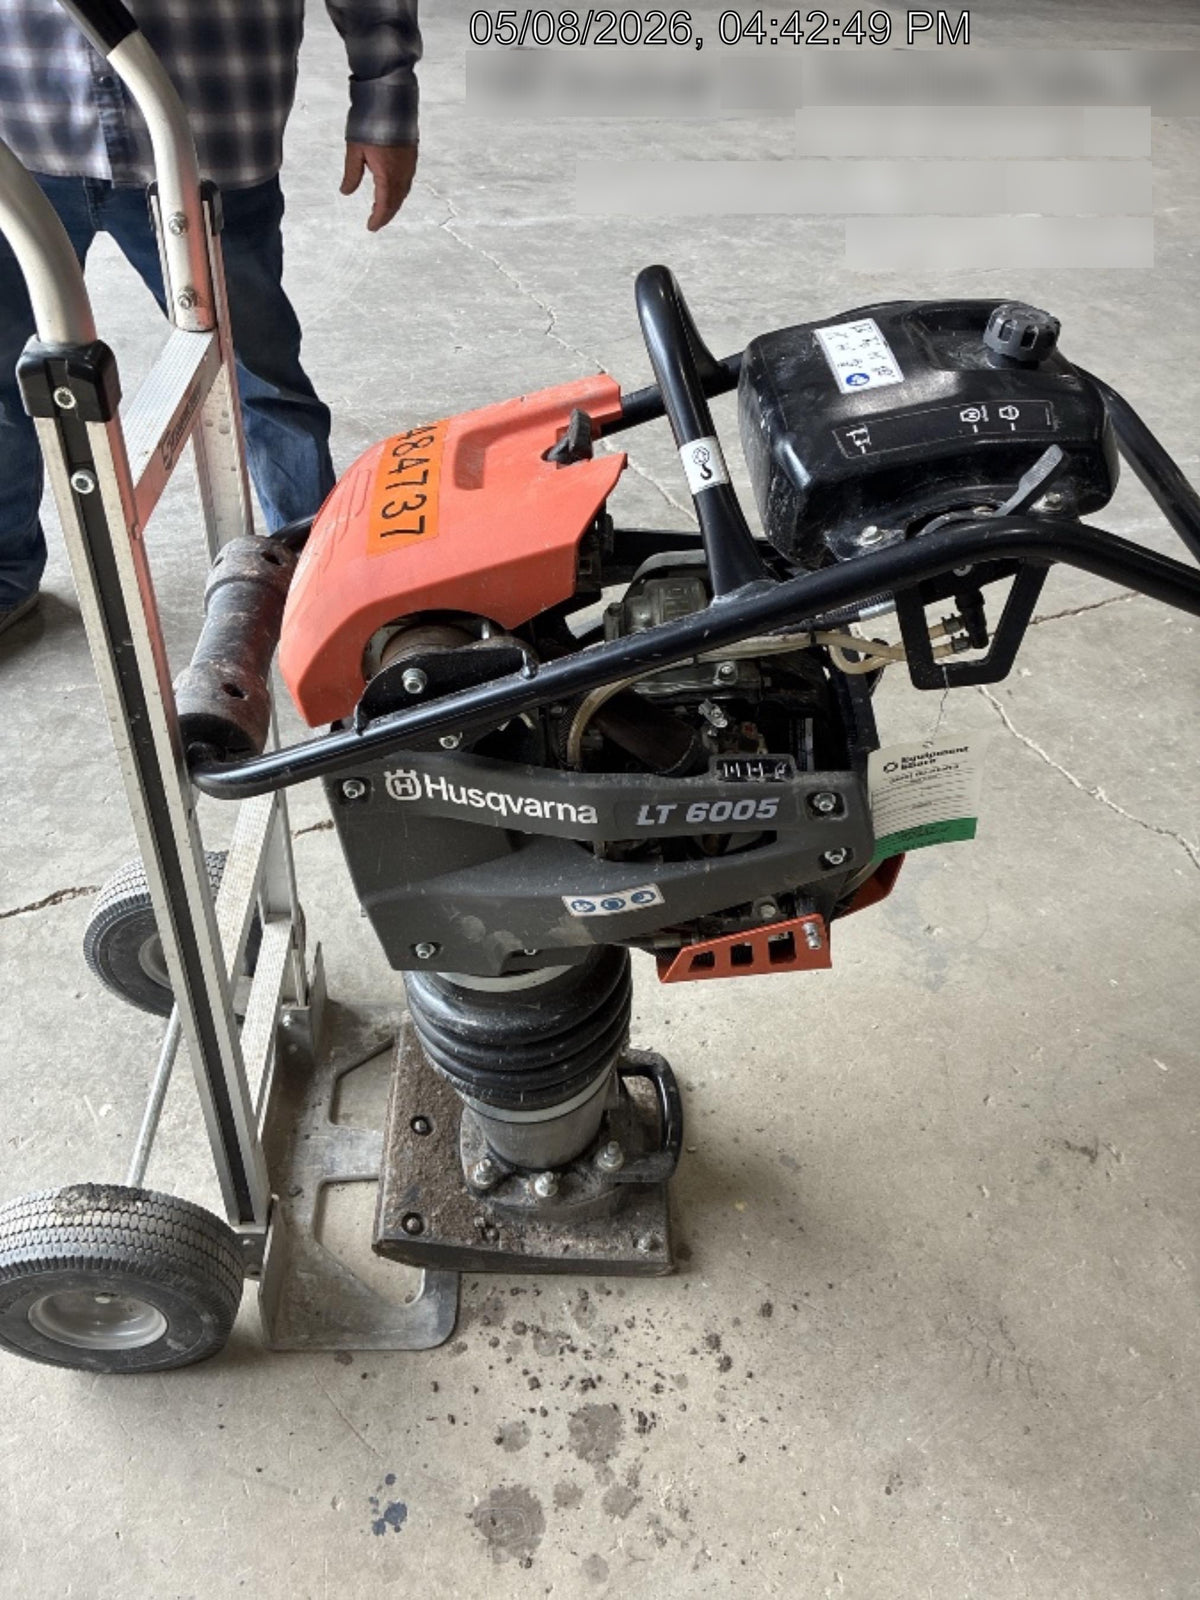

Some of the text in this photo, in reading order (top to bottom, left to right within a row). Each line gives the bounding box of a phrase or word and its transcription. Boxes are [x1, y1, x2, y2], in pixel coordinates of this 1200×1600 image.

[380, 426, 437, 538] 484737
[424, 773, 599, 824] Husqvarna
[636, 797, 781, 826] LT 6005
